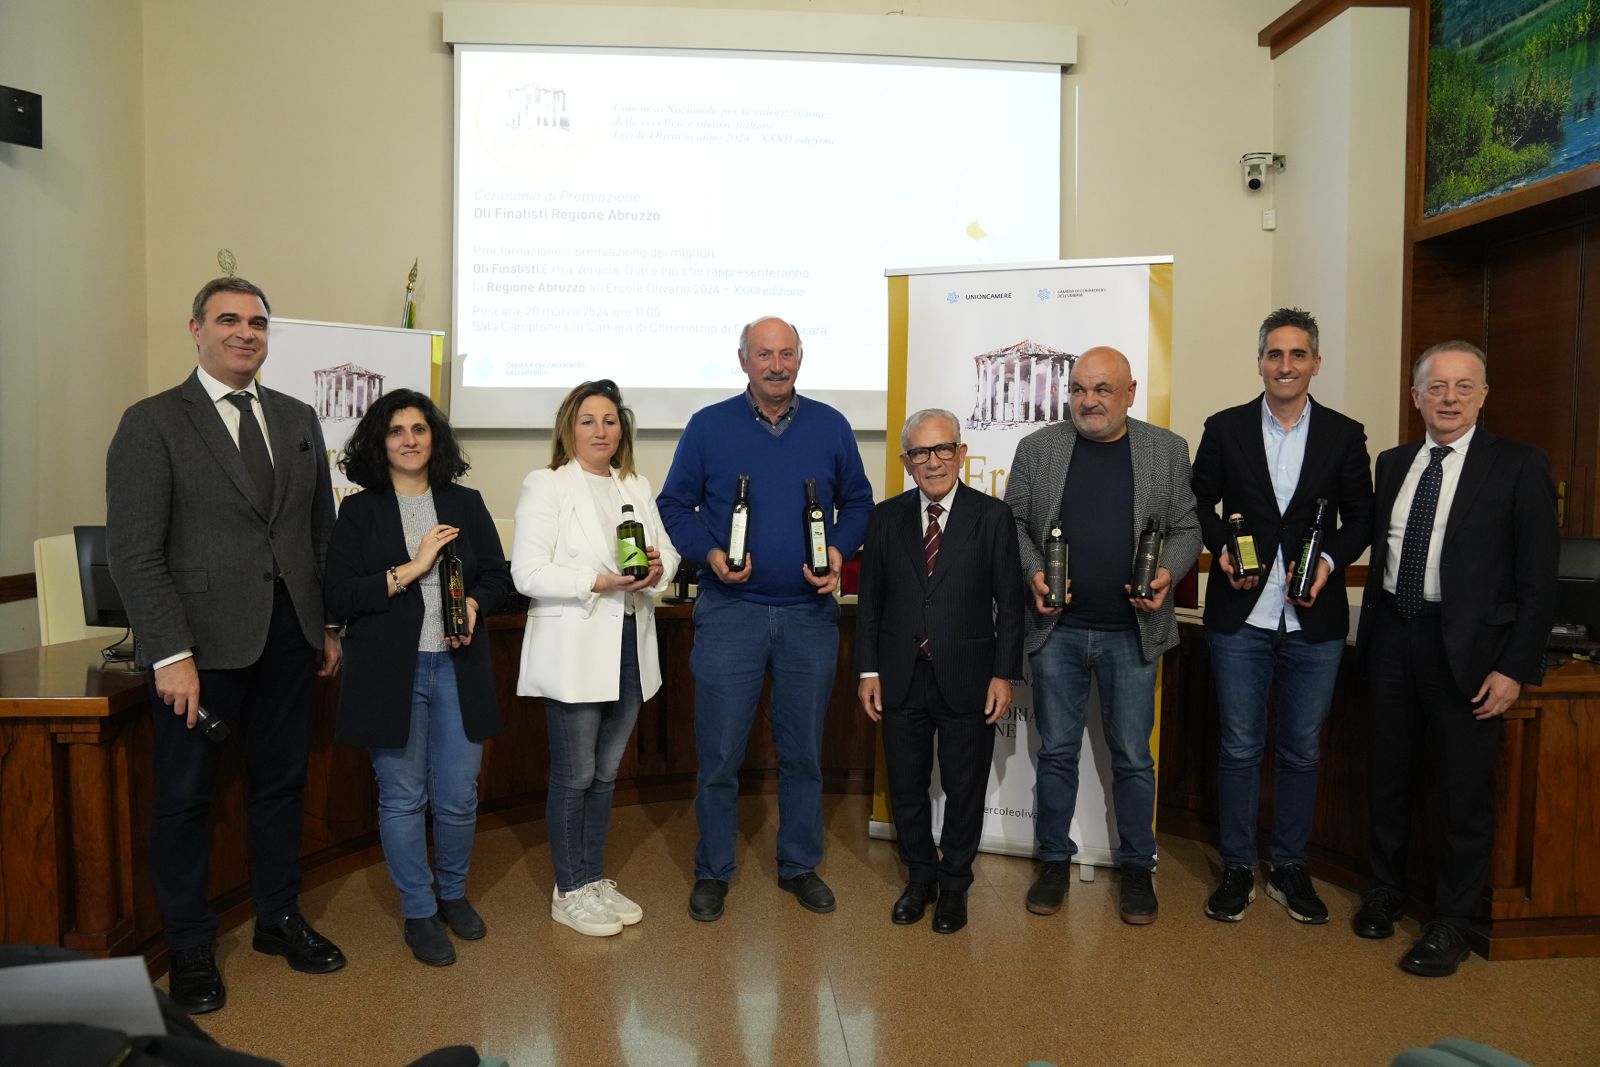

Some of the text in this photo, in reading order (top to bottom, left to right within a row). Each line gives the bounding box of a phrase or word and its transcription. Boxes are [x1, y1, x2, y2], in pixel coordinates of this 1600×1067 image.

[725, 132, 751, 144] 2024
[795, 135, 838, 147] edizione
[474, 188, 641, 204] Cerimonia di Premiazione
[473, 207, 661, 223] Oli Finalisti Regione Abruzzo
[473, 244, 561, 257] Proclamazione
[574, 245, 648, 260] premiazione
[670, 247, 715, 260] migliori
[473, 263, 489, 274] Oli
[491, 263, 540, 274] Finalisti
[542, 263, 573, 275] Extra
[624, 264, 649, 278] Dop
[682, 265, 703, 277] che
[706, 266, 810, 281] rappresenteranno
[486, 281, 535, 295] Regione
[537, 282, 586, 293] Abruzzo
[646, 282, 691, 294] Olivario
[693, 283, 721, 295] 2024
[762, 286, 806, 298] edizione
[964, 292, 1013, 300] UNIONCAMERE
[542, 307, 580, 318] marzo
[583, 305, 609, 318] 2024
[612, 308, 632, 318] ore
[472, 320, 498, 332] Sala
[563, 321, 584, 333] c/o
[586, 322, 633, 334] Camera
[635, 322, 647, 334] di
[649, 322, 718, 335] Commercio
[720, 322, 732, 335] di
[797, 325, 828, 337] scara
